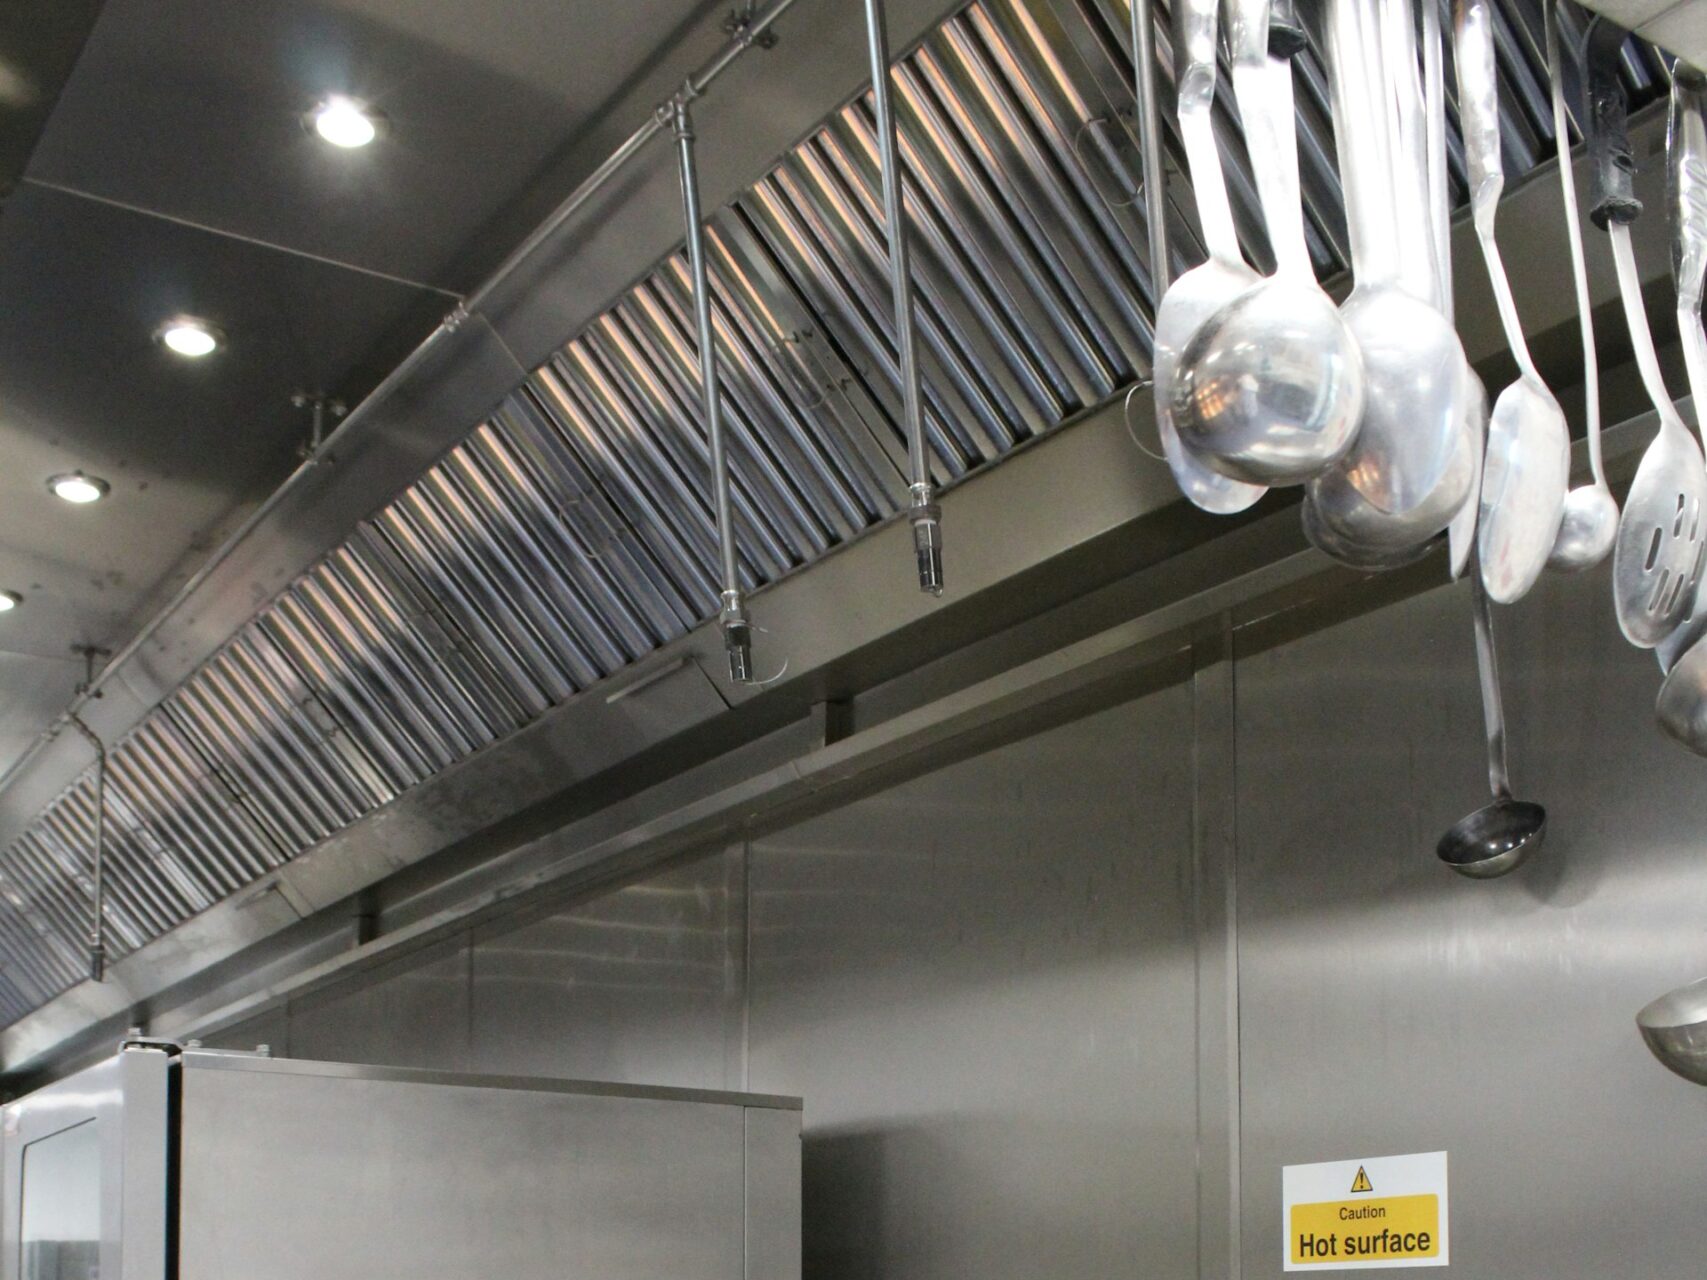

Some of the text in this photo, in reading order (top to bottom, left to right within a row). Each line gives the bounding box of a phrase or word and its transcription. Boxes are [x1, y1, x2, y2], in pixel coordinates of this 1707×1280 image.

[1339, 1205, 1386, 1221] Caution
[1299, 1228, 1431, 1258] Hot surface
